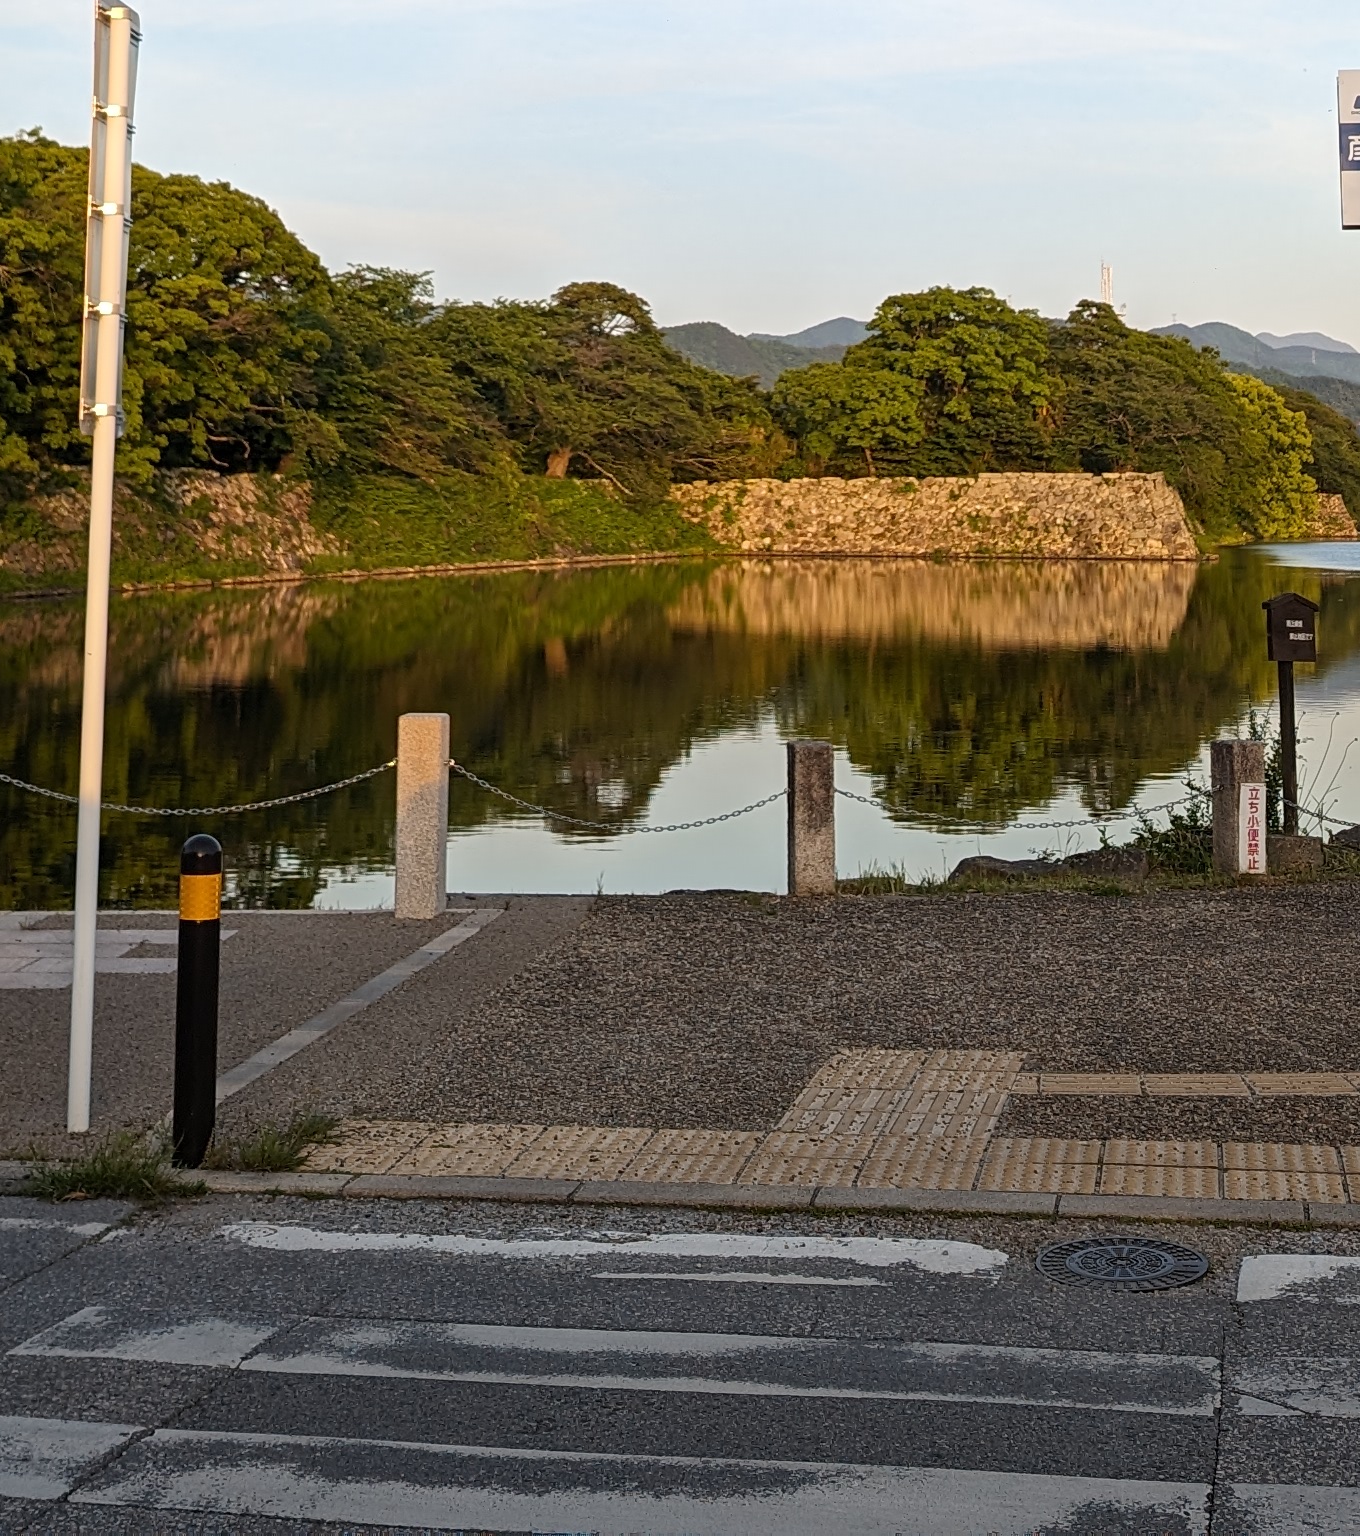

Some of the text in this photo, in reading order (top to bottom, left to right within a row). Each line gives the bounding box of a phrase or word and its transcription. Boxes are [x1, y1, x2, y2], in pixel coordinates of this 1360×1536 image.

[1247, 787, 1260, 870] 立ち小便禁止
